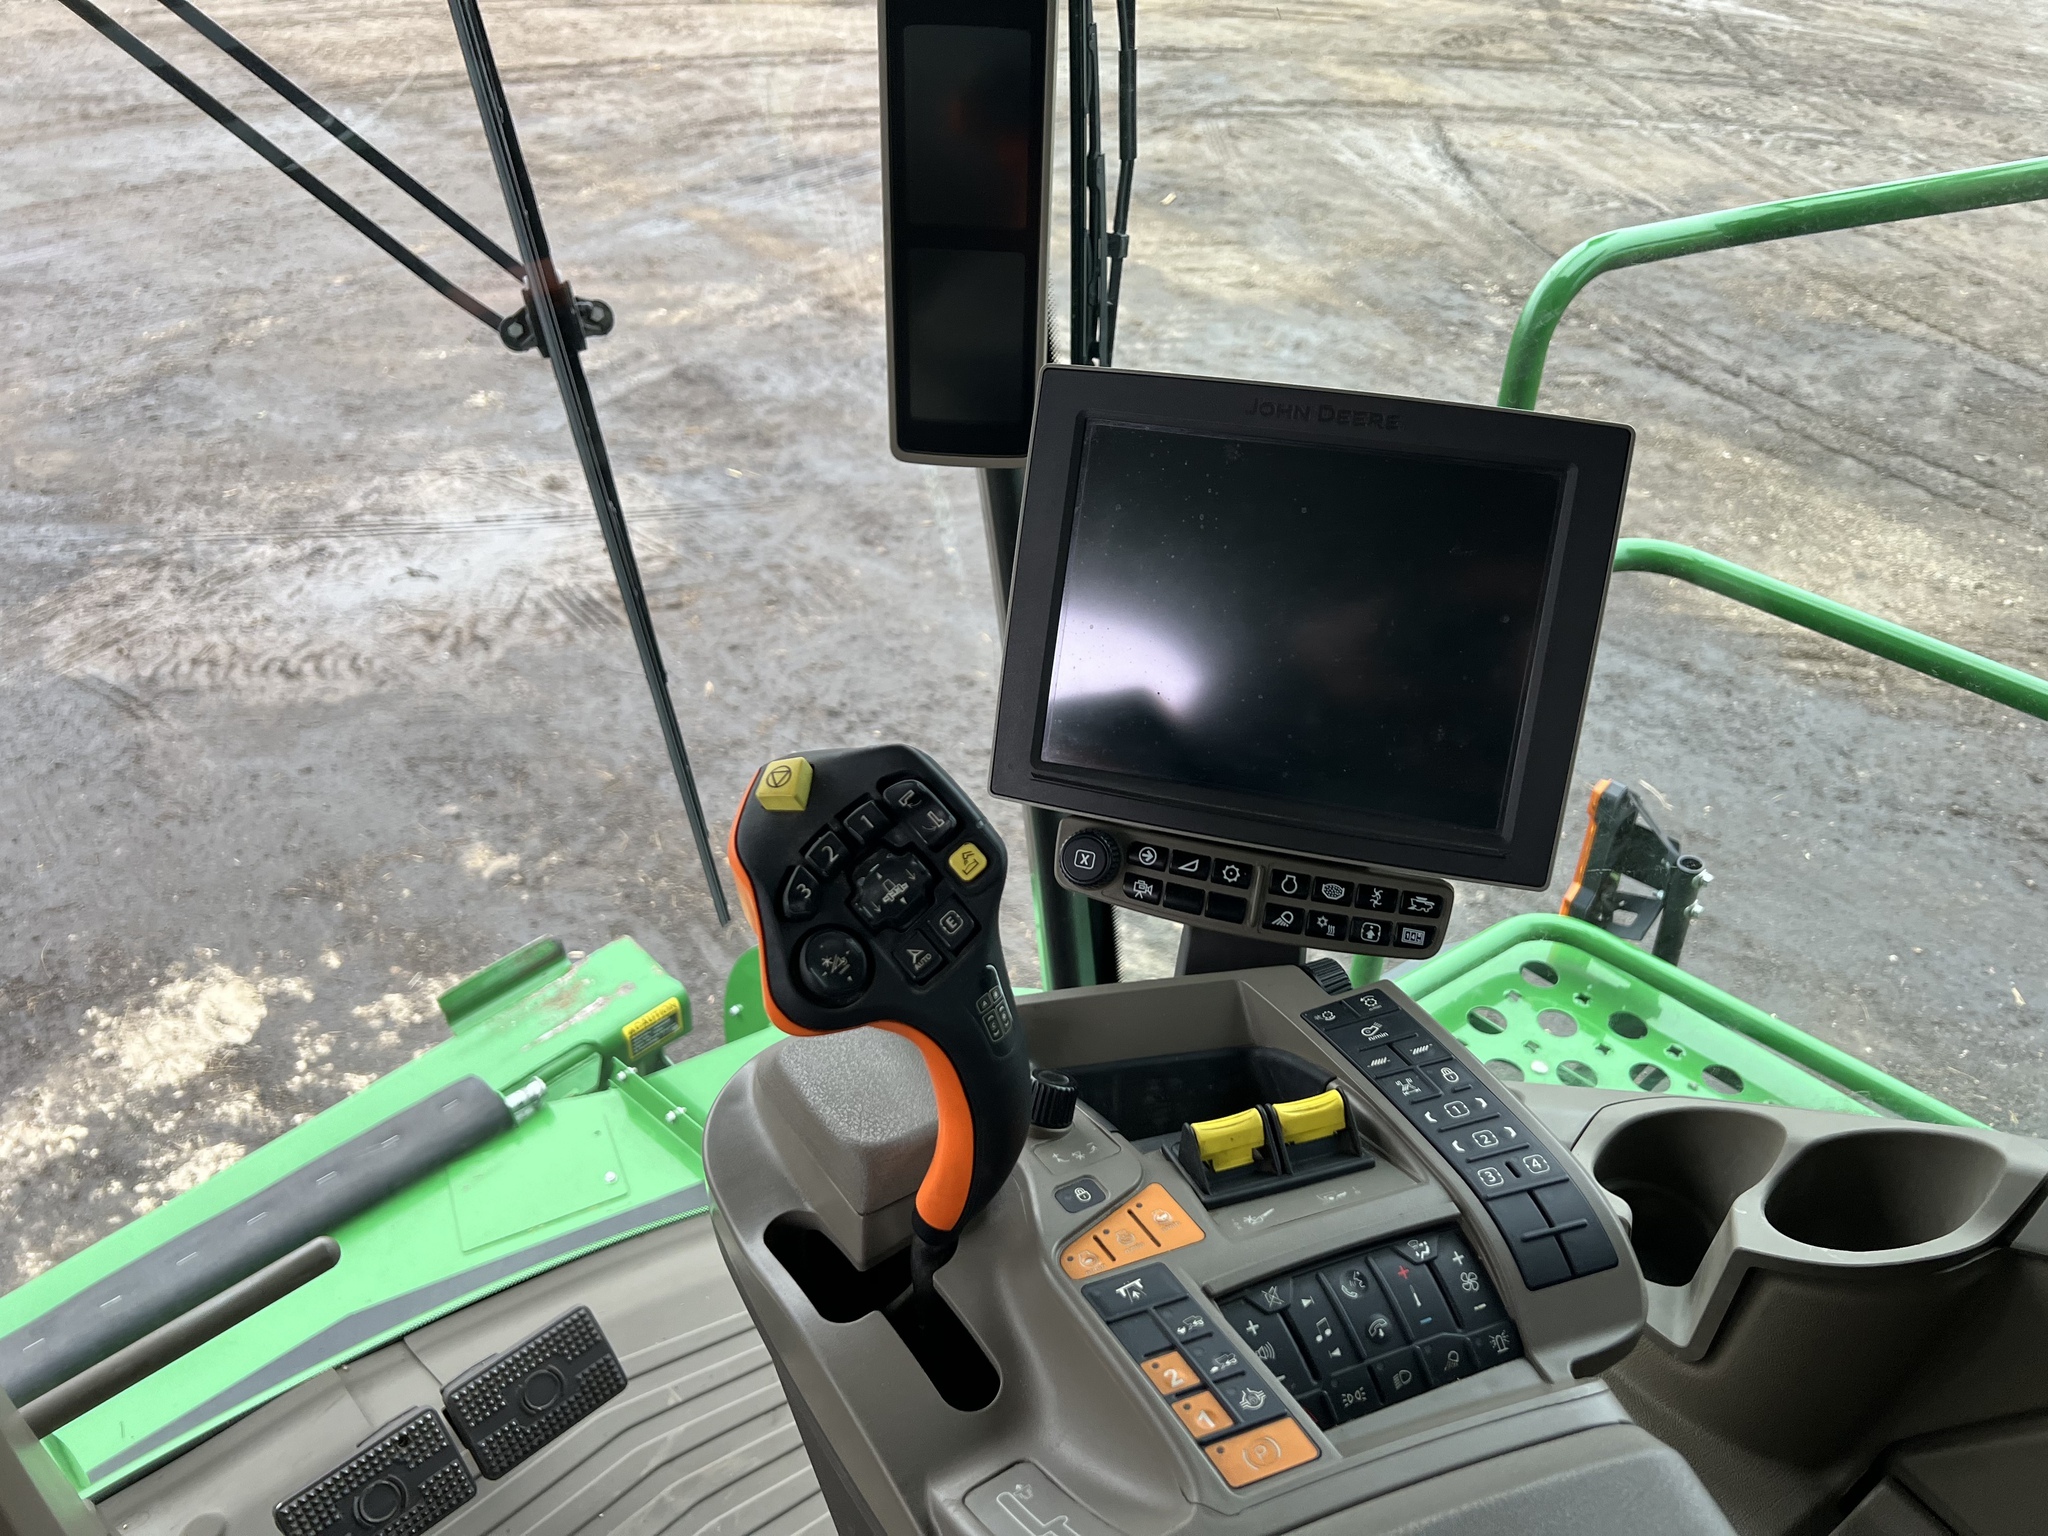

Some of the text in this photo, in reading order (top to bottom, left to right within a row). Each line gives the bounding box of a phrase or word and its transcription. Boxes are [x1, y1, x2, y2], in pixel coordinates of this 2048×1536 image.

[1245, 398, 1401, 430] JOHN DEERE
[861, 814, 875, 828] 1
[821, 845, 839, 862] 2
[796, 883, 812, 899] 3
[945, 916, 958, 929] E
[914, 953, 932, 971] AUTO
[633, 1002, 678, 1030] CAUTION
[1452, 1105, 1461, 1114] 1
[1480, 1134, 1491, 1144] 2
[1532, 1158, 1542, 1169] 4
[1484, 1171, 1496, 1182] 3
[1163, 1368, 1185, 1388] 2
[1198, 1409, 1216, 1429] 1
